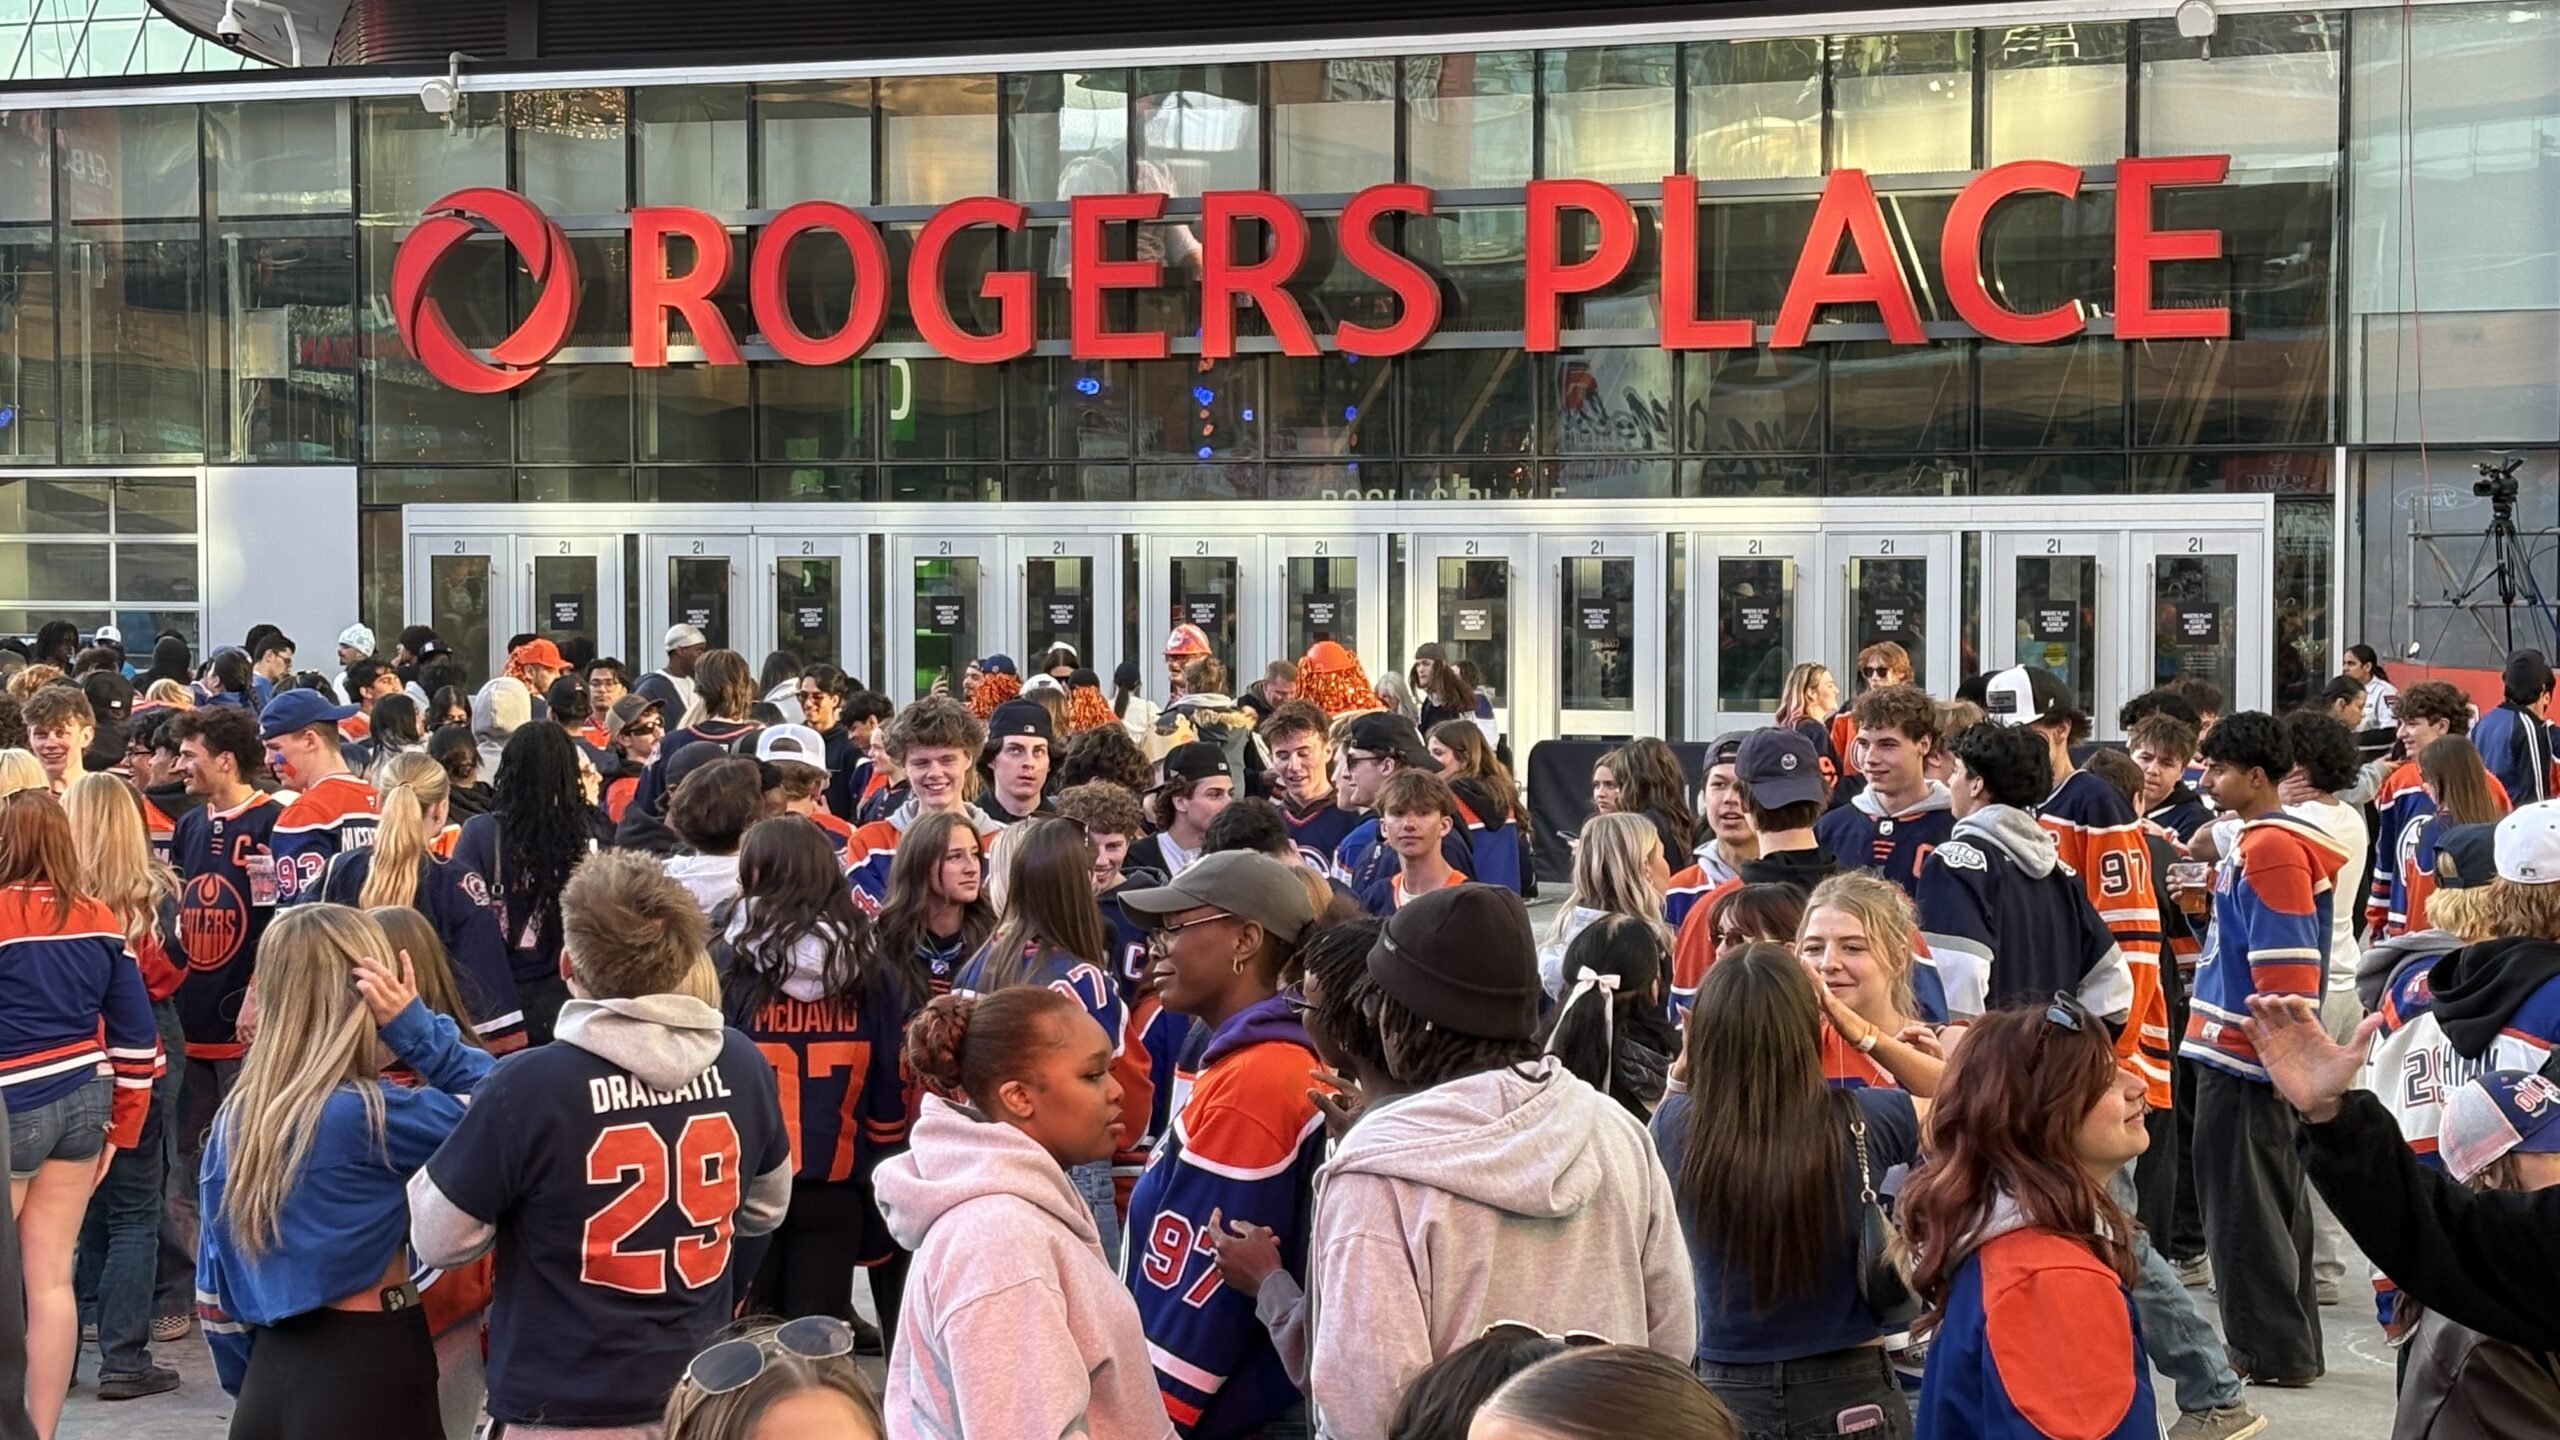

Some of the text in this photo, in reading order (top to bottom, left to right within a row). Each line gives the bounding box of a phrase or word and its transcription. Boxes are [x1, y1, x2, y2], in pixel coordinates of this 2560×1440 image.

[630, 154, 2231, 368] ROGERS PLACE
[454, 540, 466, 554] 21
[559, 540, 571, 554] 21
[692, 540, 705, 555] 21
[802, 540, 815, 555] 21
[939, 540, 952, 555] 21
[1052, 540, 1066, 555] 21
[1196, 540, 1209, 555] 21
[1314, 540, 1328, 555] 21
[1465, 540, 1479, 555] 21
[1590, 539, 1604, 555] 21
[1748, 539, 1762, 555] 21
[1880, 539, 1895, 555] 21
[2046, 538, 2061, 554] 21
[2188, 537, 2203, 553] 21
[232, 835, 251, 867] C
[276, 852, 326, 898] 93
[2100, 850, 2147, 897] 97
[1124, 942, 1146, 980] C
[580, 1111, 742, 1295] 29
[1142, 1209, 1225, 1308] 97
